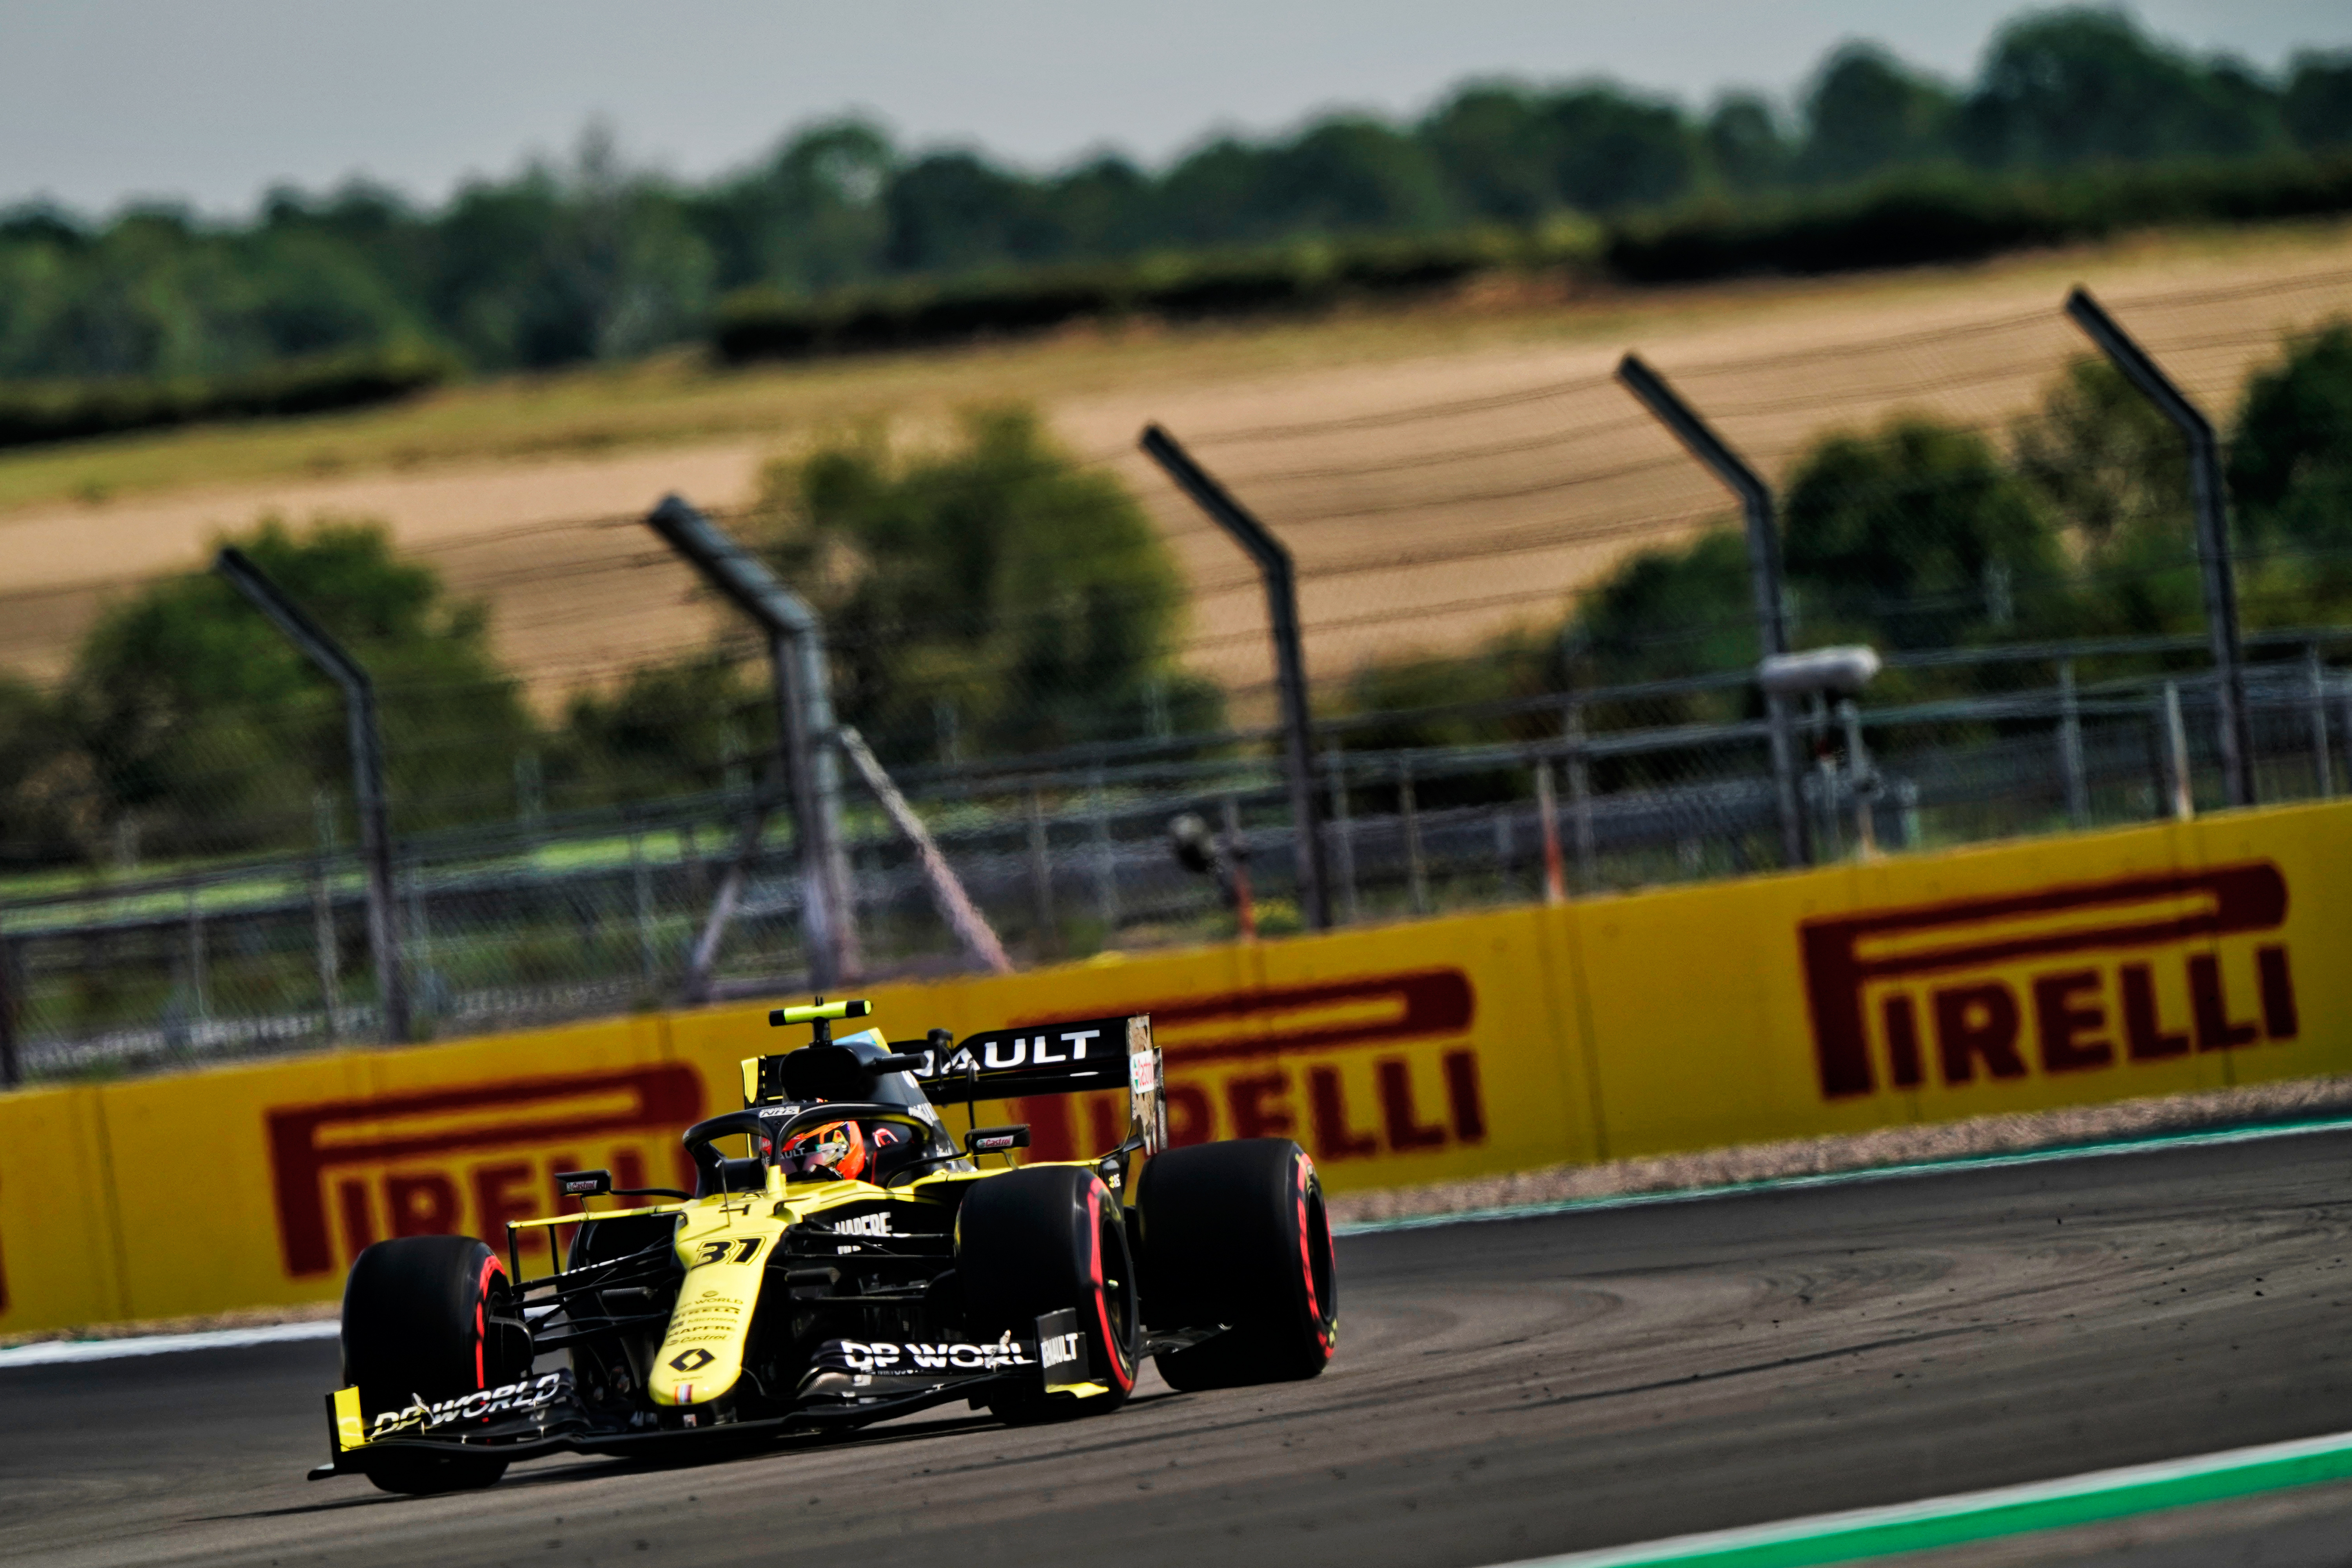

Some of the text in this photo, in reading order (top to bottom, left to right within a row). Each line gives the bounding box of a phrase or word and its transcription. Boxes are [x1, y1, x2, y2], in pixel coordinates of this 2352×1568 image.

[1797, 857, 2298, 1103] PIRELLI
[911, 1029, 1100, 1077] AULT
[986, 1136, 1012, 1147] Castrol
[762, 1147, 805, 1165] REAULT
[572, 1181, 595, 1190] Castrol
[689, 1236, 766, 1272] 31
[668, 1326, 736, 1338] MAPFRE
[680, 1335, 726, 1343] Castrol
[840, 1340, 1038, 1368] DP WORL
[431, 1373, 560, 1423] WORLD
